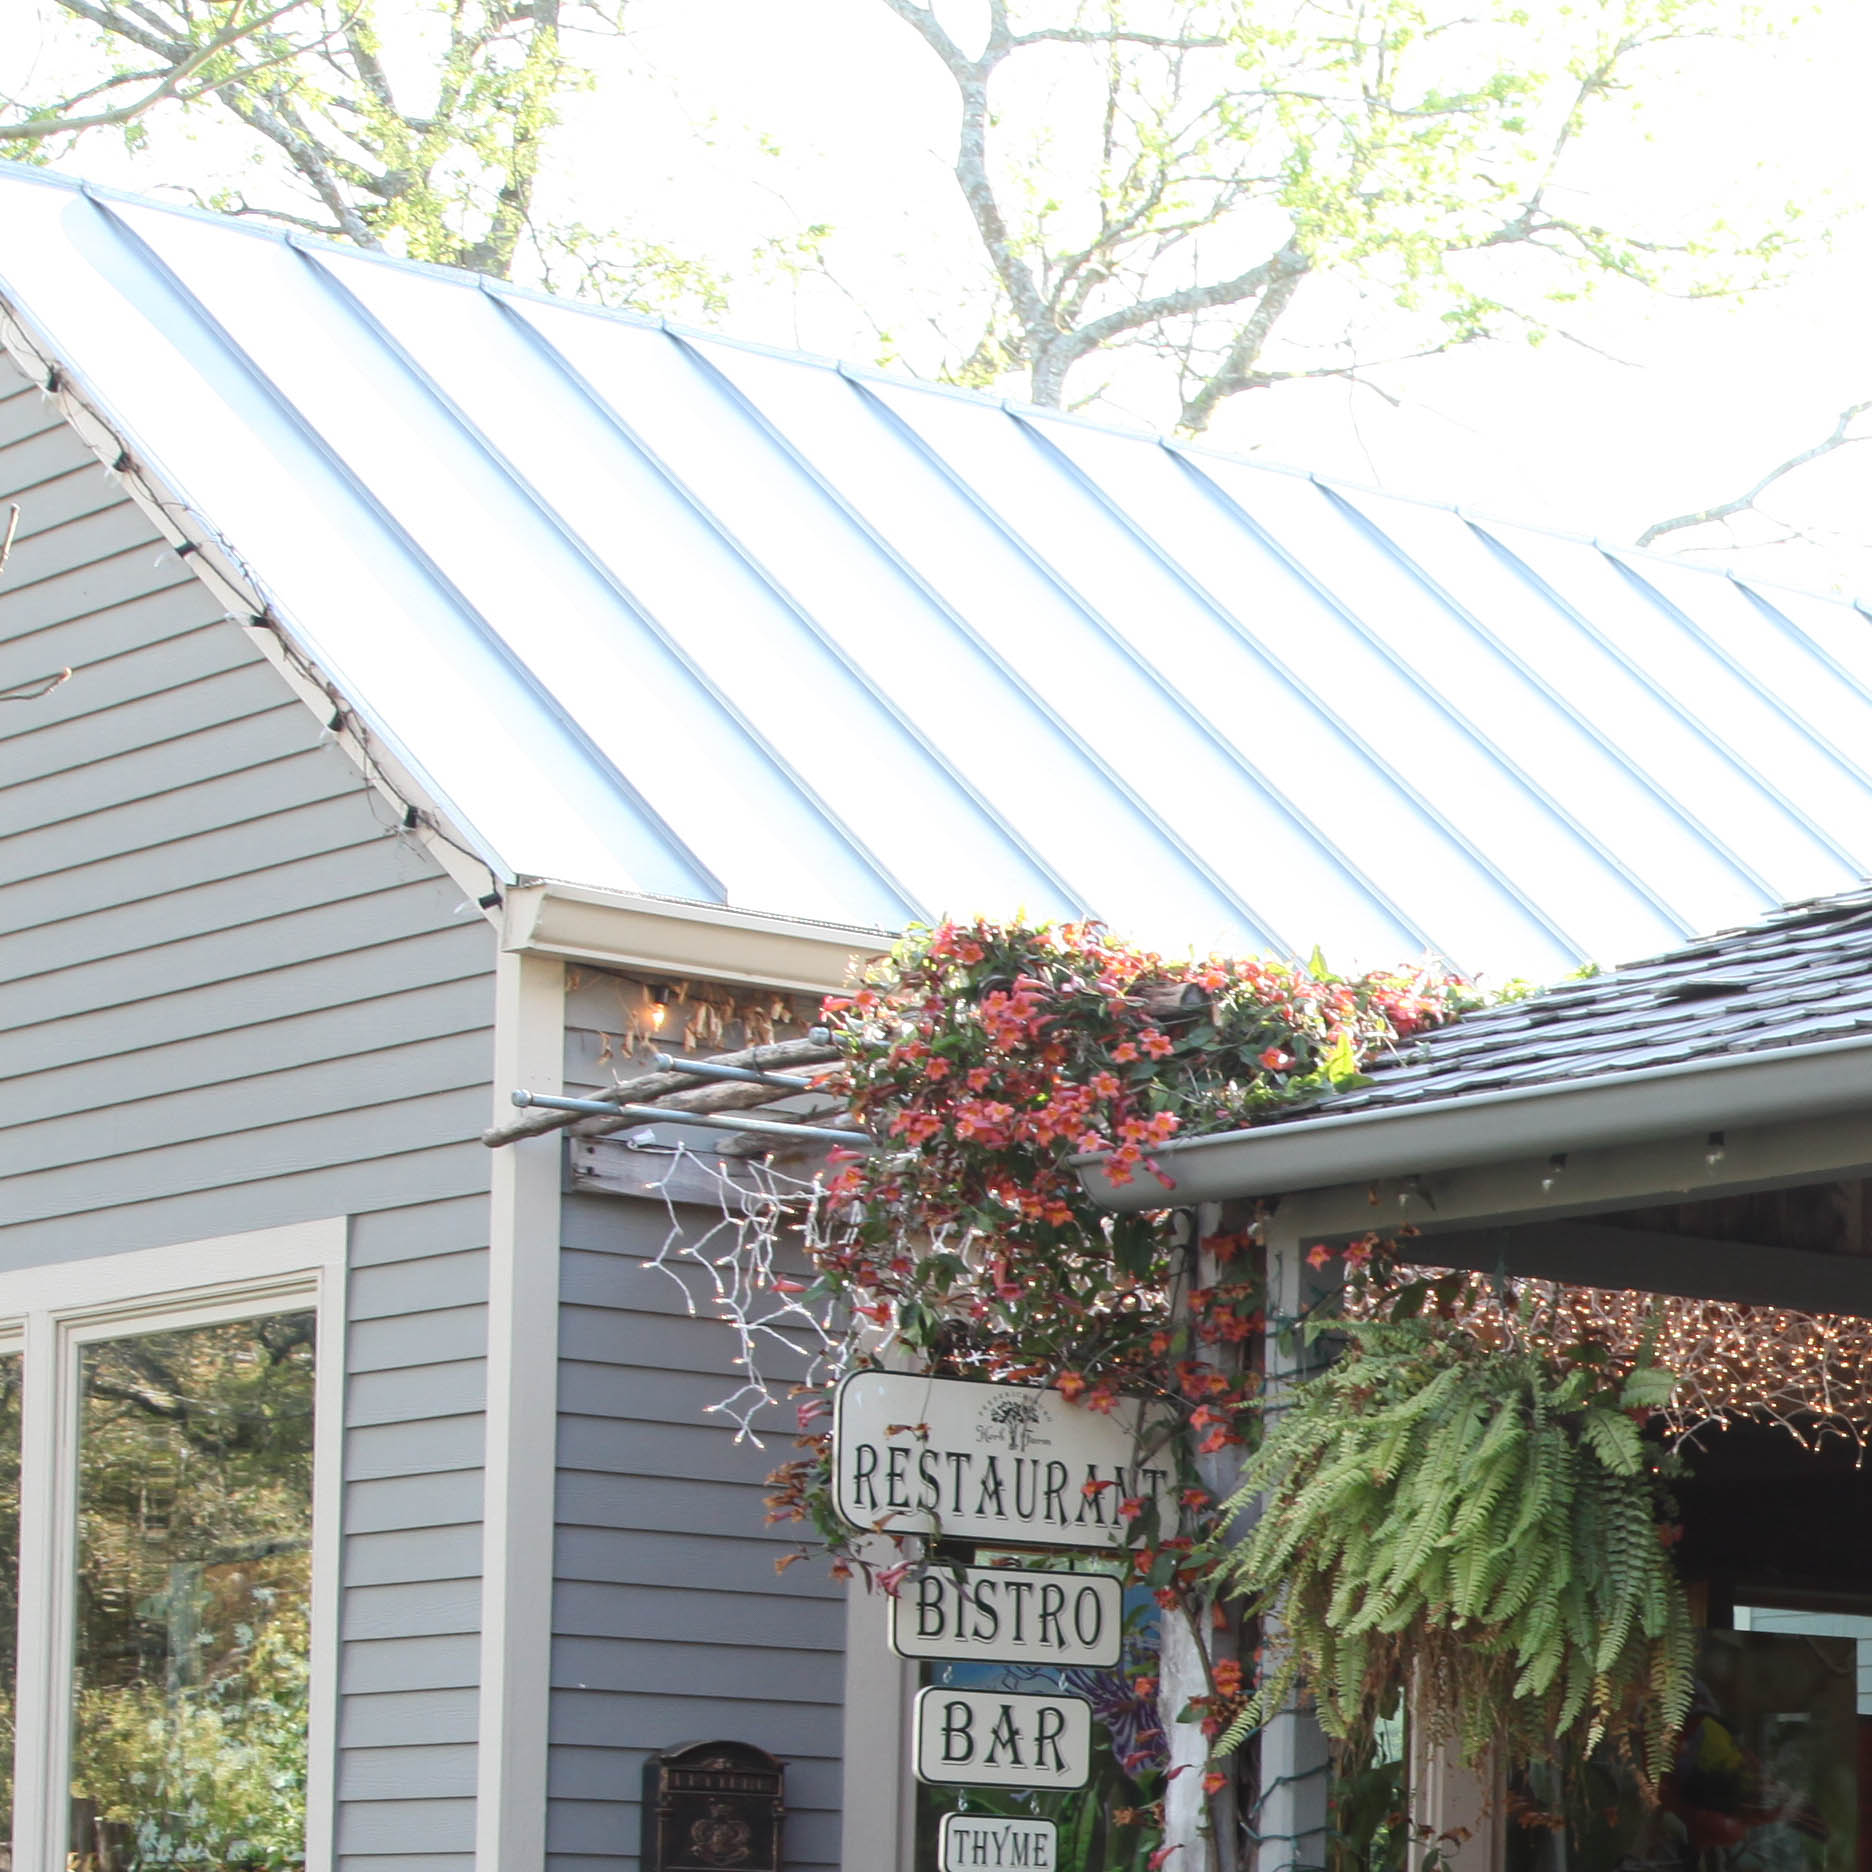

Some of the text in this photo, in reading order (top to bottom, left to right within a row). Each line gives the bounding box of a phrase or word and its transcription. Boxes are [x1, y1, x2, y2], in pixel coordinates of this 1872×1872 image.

[916, 1575, 1104, 1651] BISTRO
[941, 1699, 1069, 1776] BAR
[953, 1824, 1049, 1869] THYME
